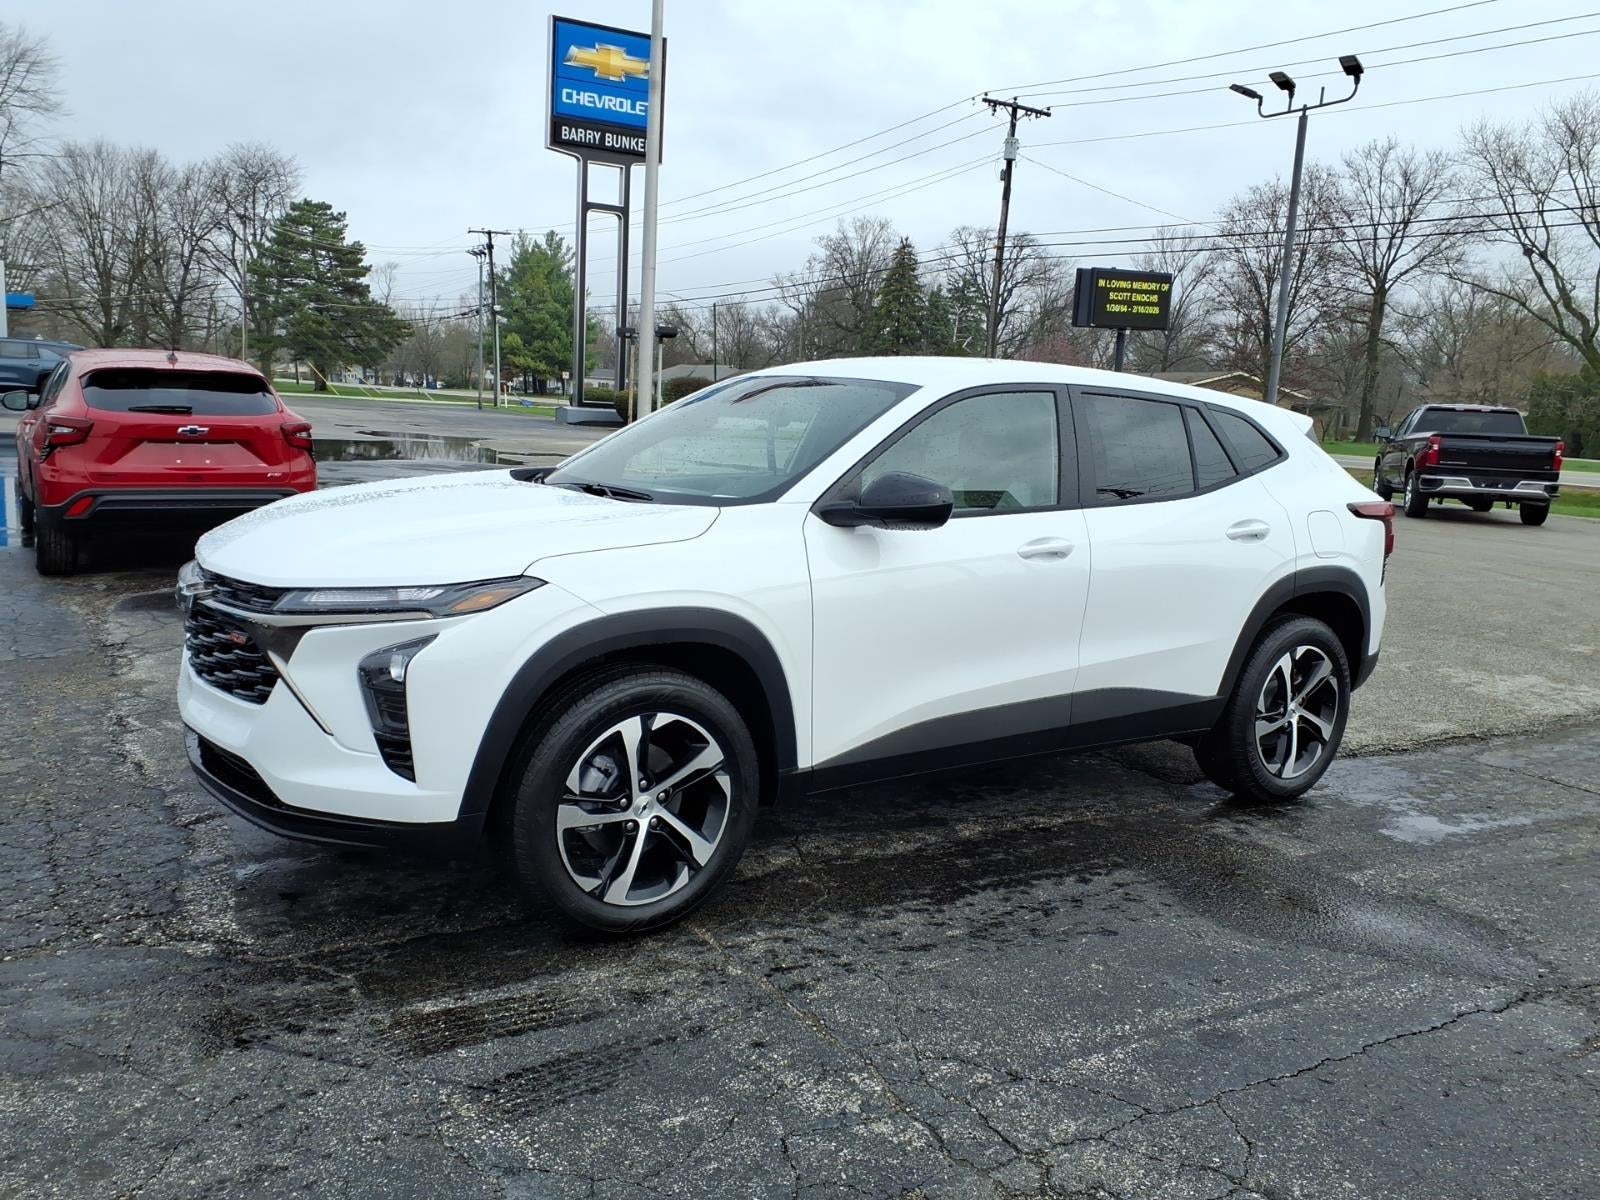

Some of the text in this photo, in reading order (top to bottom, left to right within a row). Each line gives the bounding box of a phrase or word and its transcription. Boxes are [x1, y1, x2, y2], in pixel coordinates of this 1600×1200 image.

[562, 88, 649, 115] CHEVROLE
[561, 126, 648, 152] BARRY BUNKE
[1098, 279, 1170, 292] IN LOVING MEMORY OF
[1109, 292, 1158, 302] SCOTT ENOCHS
